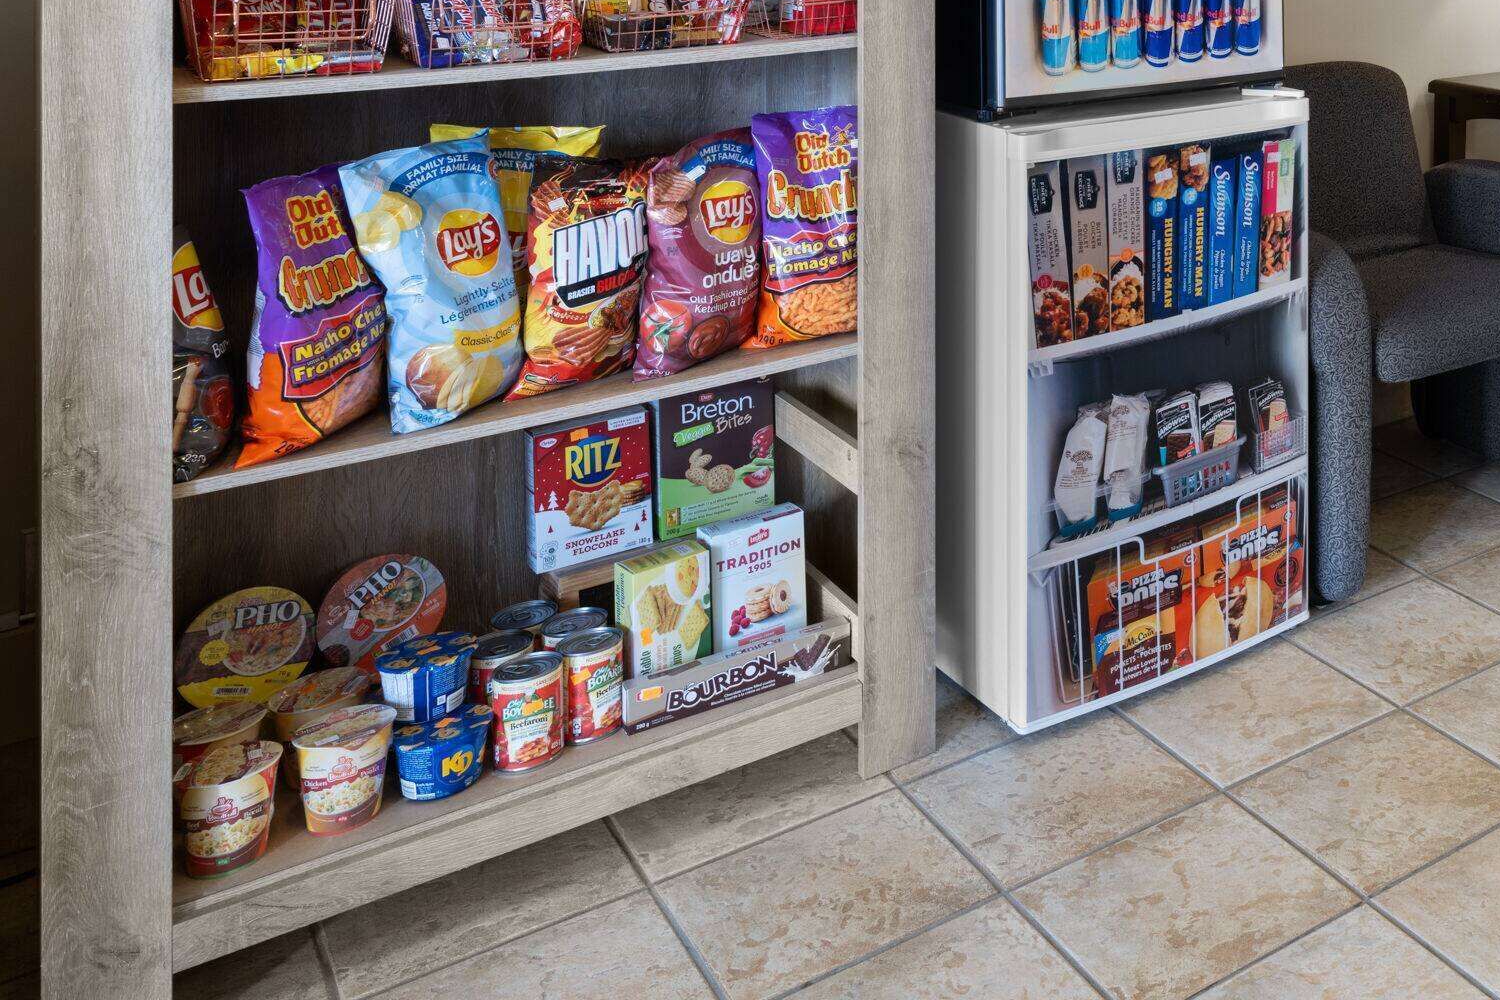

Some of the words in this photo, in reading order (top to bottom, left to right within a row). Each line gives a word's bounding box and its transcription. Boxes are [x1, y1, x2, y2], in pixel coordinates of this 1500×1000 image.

[1042, 23, 1059, 34] Bull
[722, 143, 742, 154] SIZE
[795, 131, 829, 154] Old
[405, 157, 445, 181] FAMILY
[447, 153, 470, 164] SIZE
[704, 154, 717, 165] AT
[717, 153, 755, 167] FAMILIAL
[796, 145, 850, 175] Dutch
[402, 170, 438, 197] FORMAT
[439, 162, 483, 177] FAMILIAL
[1242, 155, 1259, 228] Swanson
[285, 190, 333, 222] Old
[704, 192, 754, 230] Lay's
[1213, 165, 1232, 237] Swanson
[441, 217, 501, 261] Lay's
[768, 239, 824, 260] Nacho
[1052, 228, 1060, 259] CHICKEN
[1194, 206, 1205, 298] HUNGRY-MAN
[768, 256, 838, 276] Fromage
[1163, 217, 1173, 309] HUNGRY-MAN
[453, 285, 490, 307] Lightly
[567, 284, 596, 301] BRASIER
[689, 294, 709, 304] Old
[708, 288, 749, 304] Fashioned
[439, 293, 509, 326] Légèrement
[694, 300, 729, 315] Ketchup
[294, 323, 352, 363] Nacho
[292, 332, 369, 383] Fromage
[680, 395, 753, 425] Breton
[716, 413, 753, 434] Bites
[1201, 406, 1236, 432] SANDWICH
[673, 423, 713, 445] Veggie
[564, 437, 622, 481] RITZ
[565, 527, 626, 550] SNOWFLAKE
[572, 538, 619, 557] FLOCONS
[1240, 525, 1269, 545] PIZZA
[716, 537, 801, 573] TRADITION
[747, 560, 772, 575] 1905
[350, 560, 402, 609] PHO
[1131, 567, 1165, 590] PIZZA
[234, 600, 301, 629] PHO
[1110, 654, 1136, 674] POKETS
[666, 650, 778, 713] BOURBON
[503, 697, 555, 719] BOYEE
[510, 714, 549, 731] Beefaroni
[441, 750, 474, 778] KD
